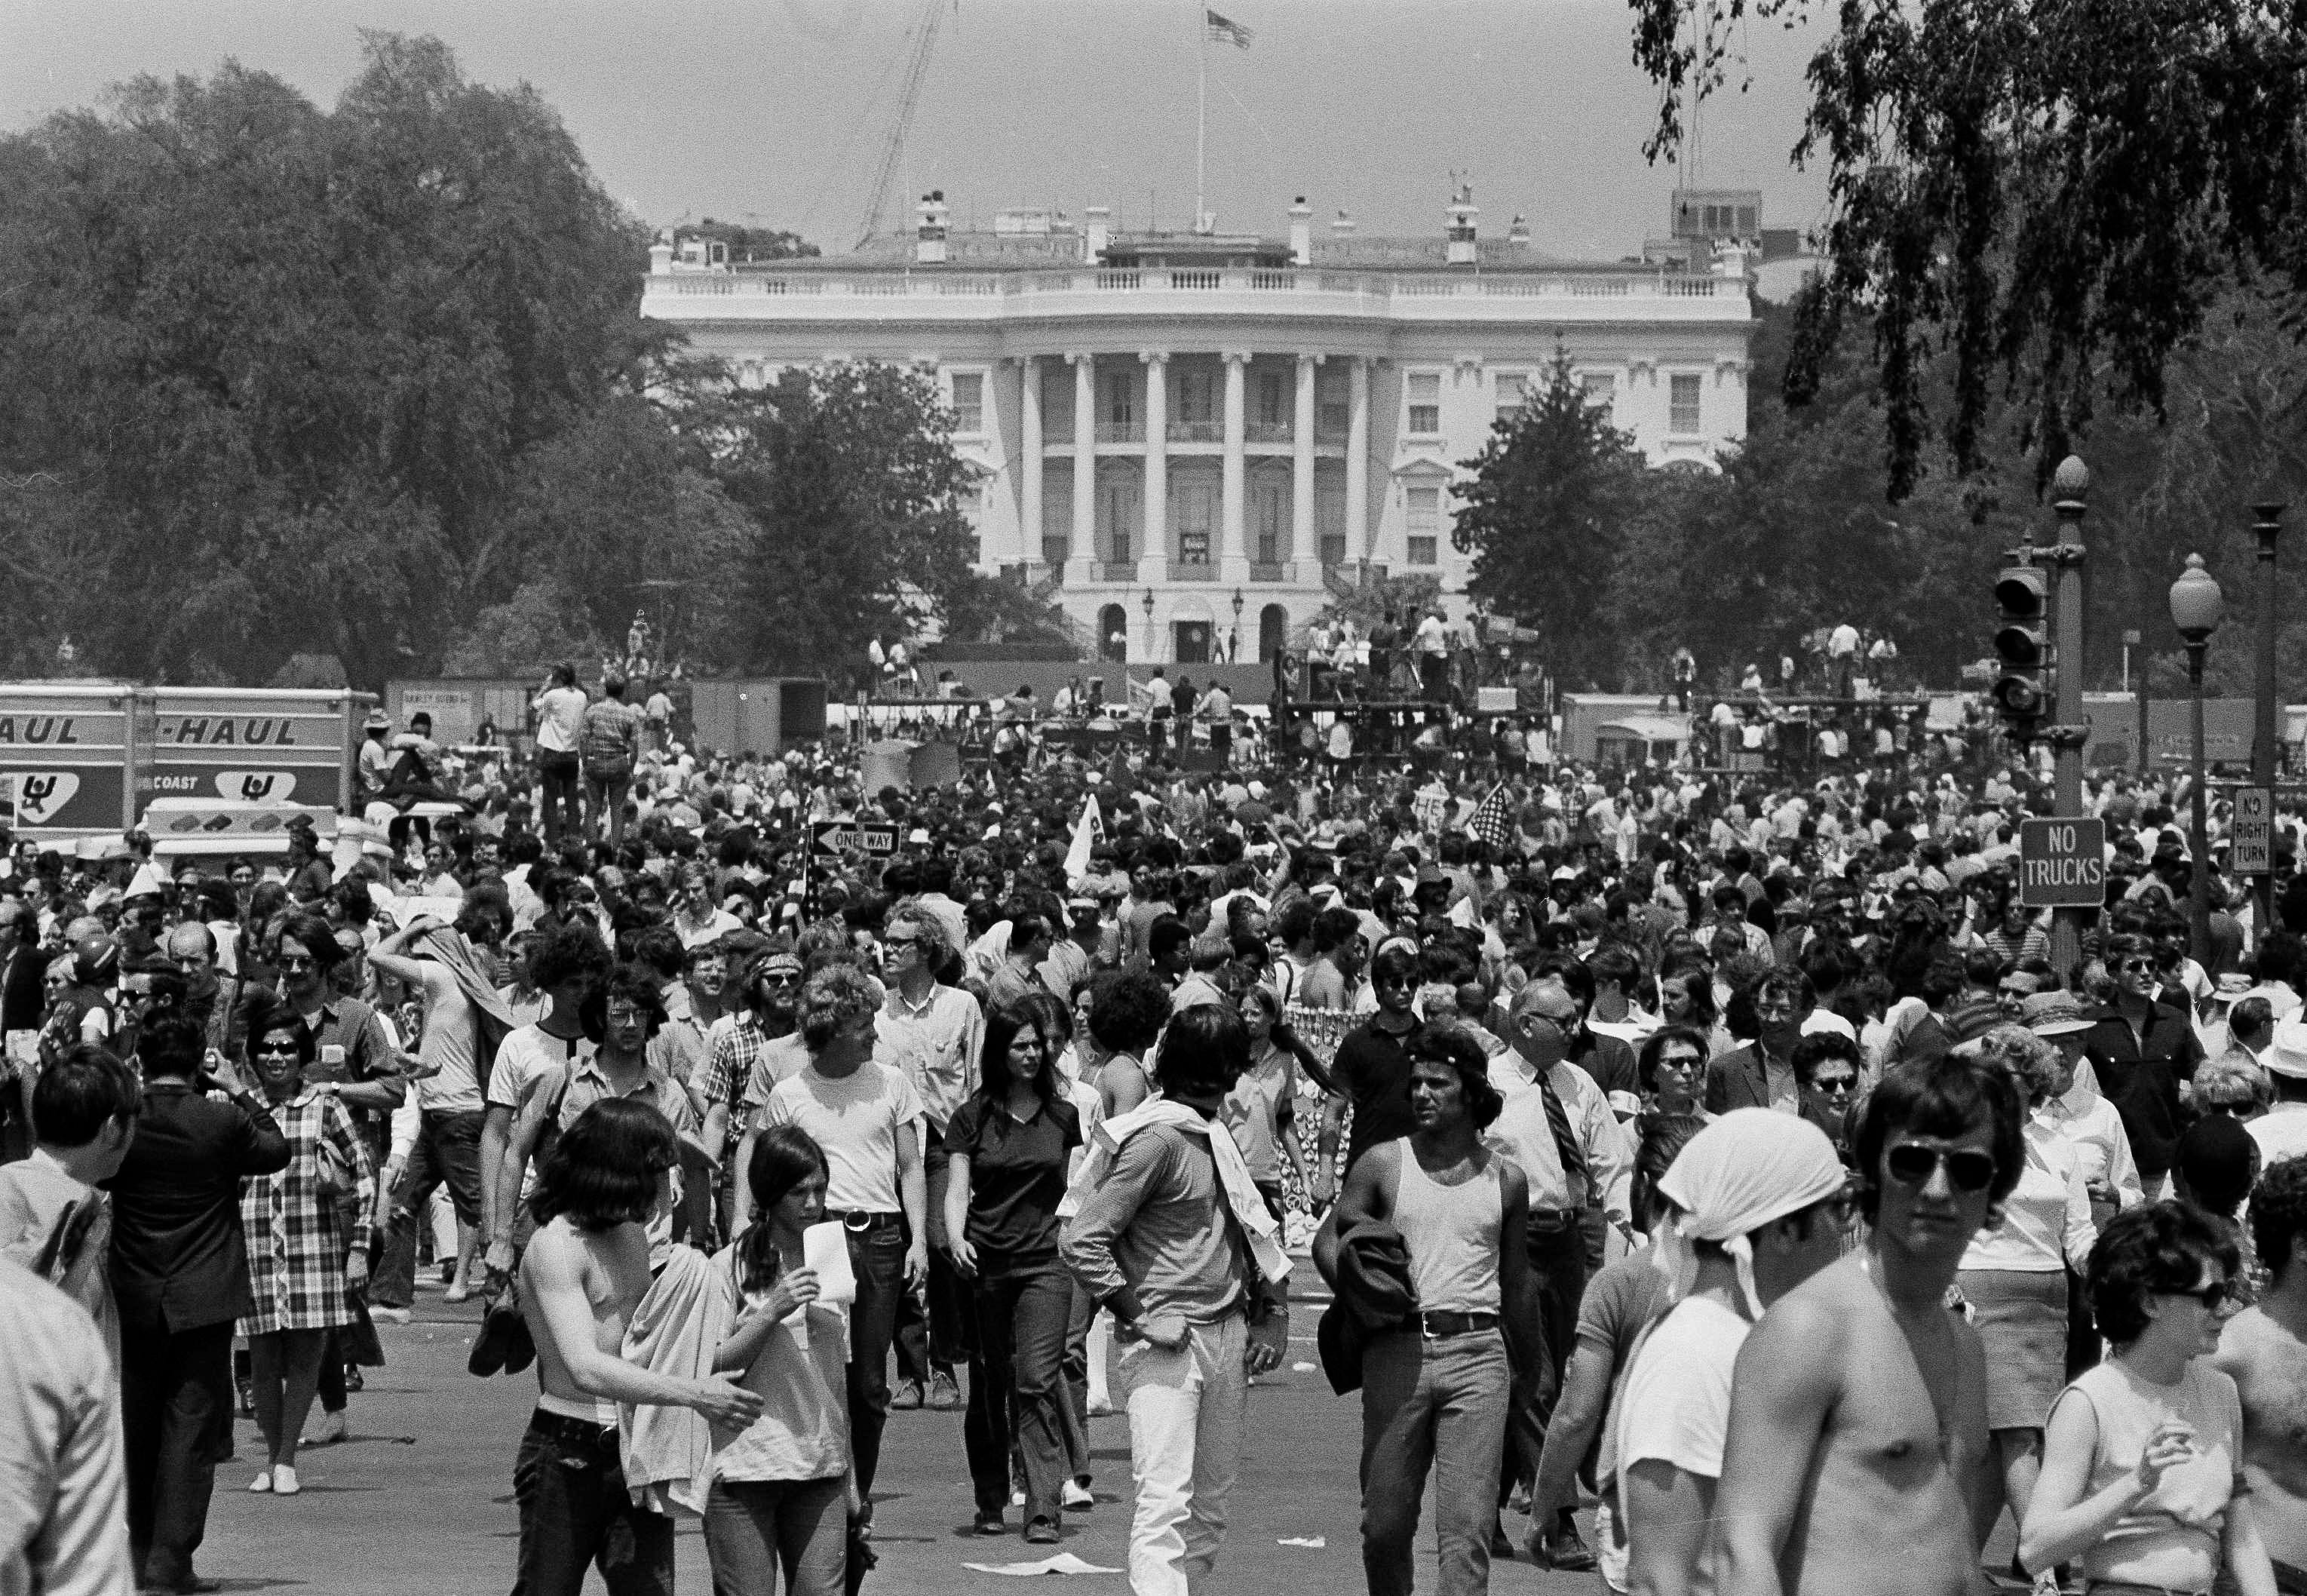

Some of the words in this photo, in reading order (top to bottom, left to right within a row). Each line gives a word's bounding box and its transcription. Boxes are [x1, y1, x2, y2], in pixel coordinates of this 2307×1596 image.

[155, 717, 295, 744] -HAUL
[154, 776, 198, 790] COAST
[2244, 797, 2261, 815] NO
[2048, 825, 2076, 853] NO
[2235, 822, 2268, 839] RIGHT
[867, 833, 891, 848] WAY
[2236, 846, 2266, 862] TURN
[2026, 858, 2101, 886] TRUCKS
